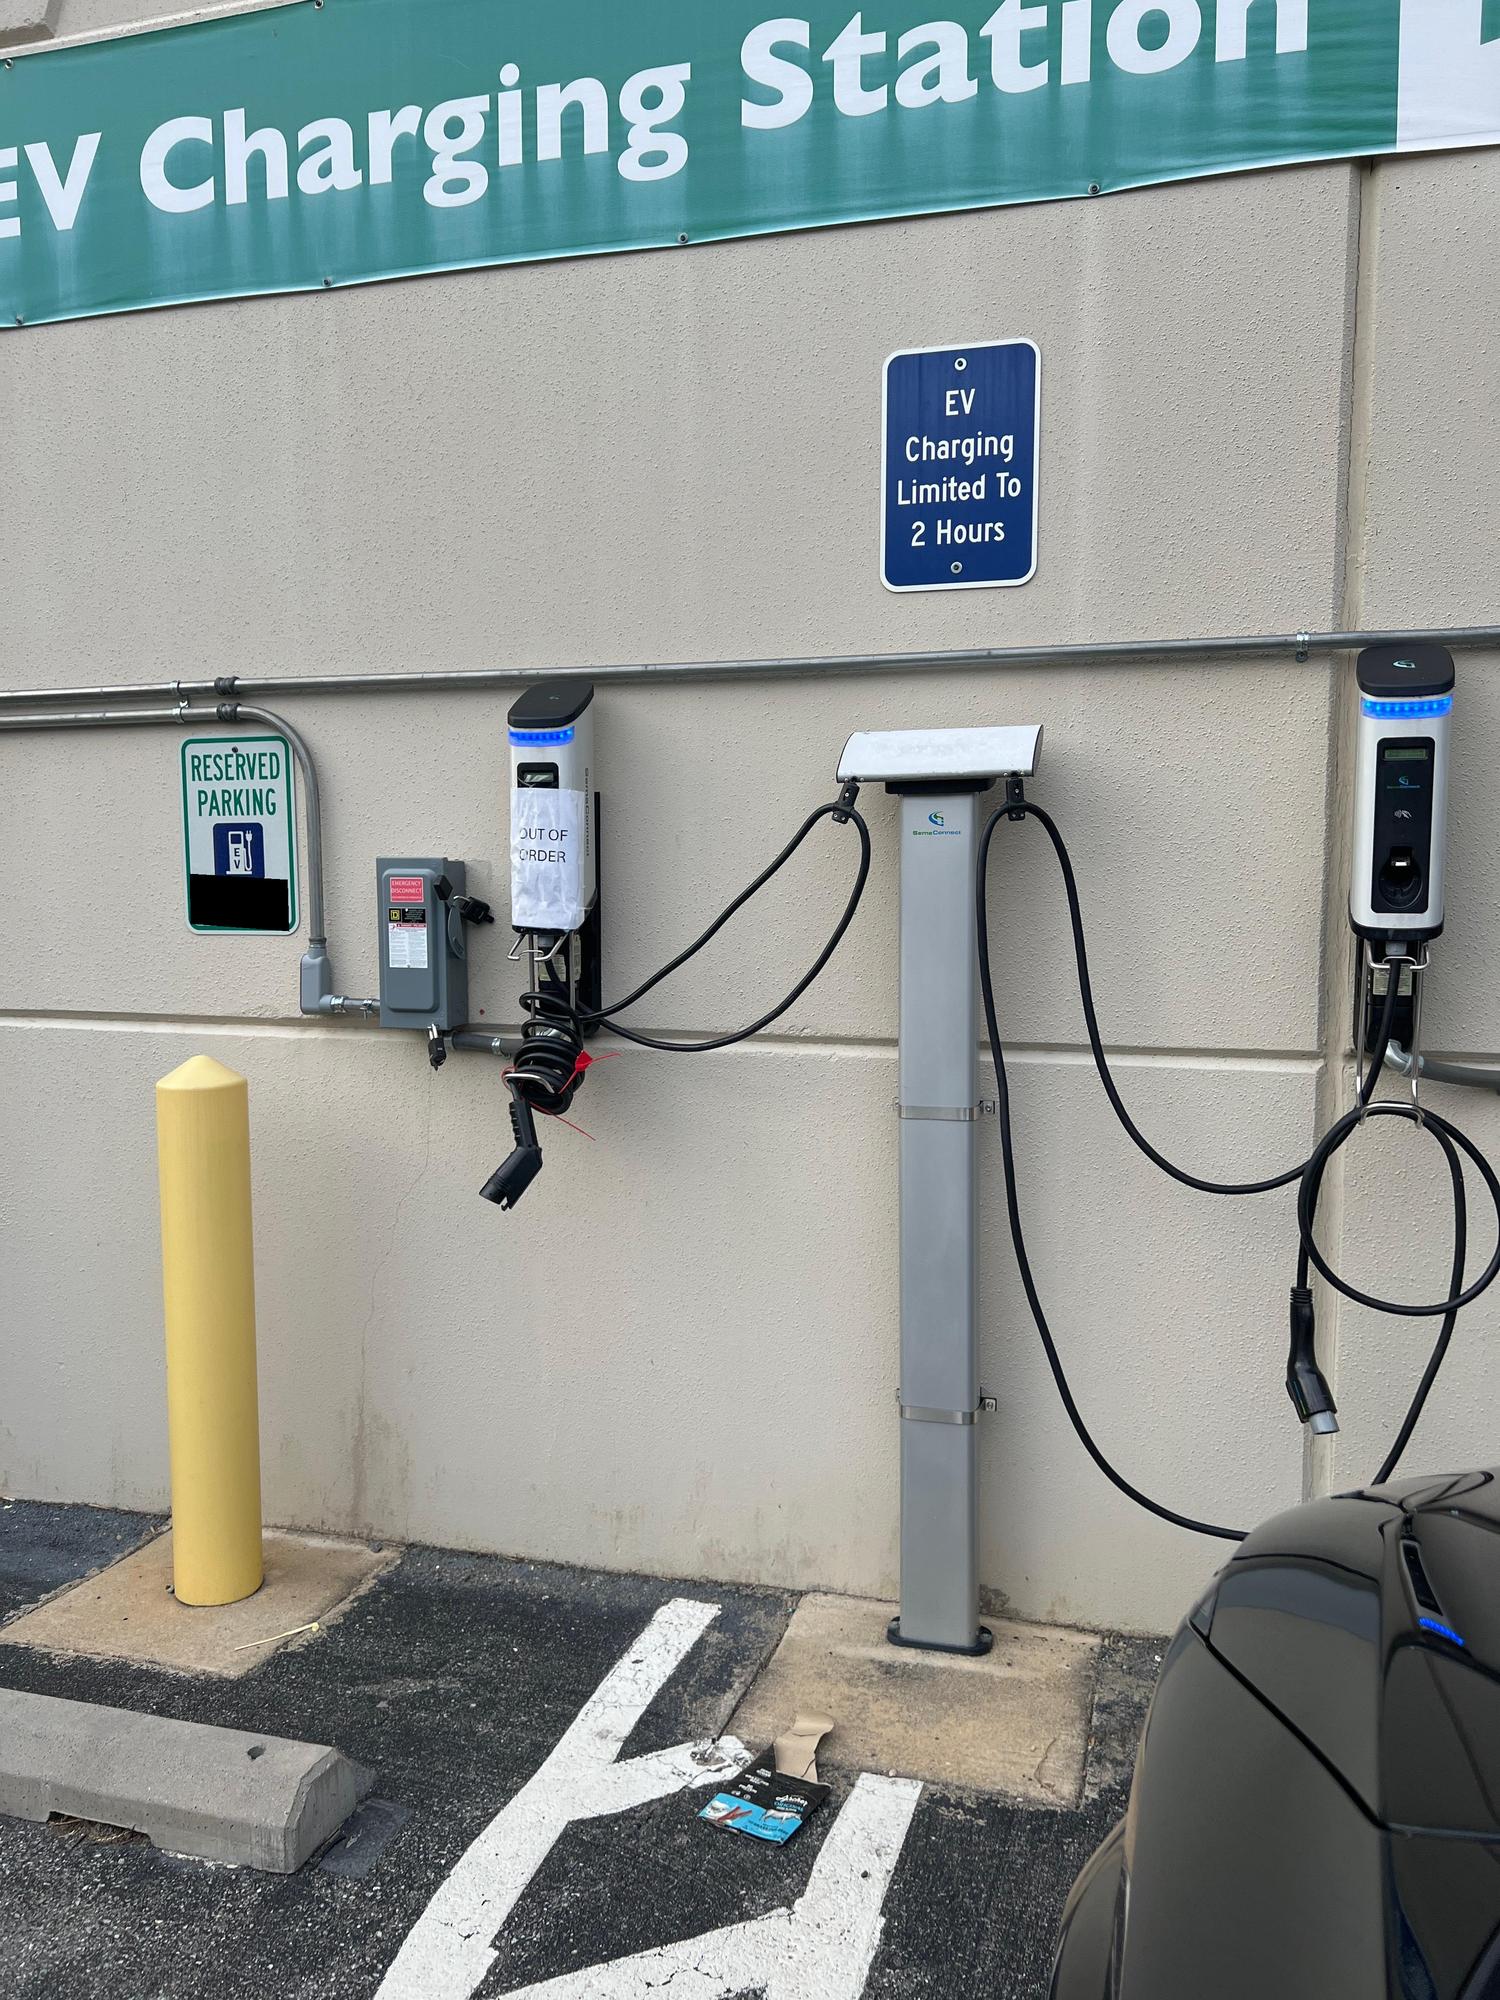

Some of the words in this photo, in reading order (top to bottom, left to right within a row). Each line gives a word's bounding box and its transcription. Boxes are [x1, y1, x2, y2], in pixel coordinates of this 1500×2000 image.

[139, 62, 691, 213] Charging
[741, 0, 1308, 130] Station
[945, 388, 975, 416] EV
[905, 431, 1014, 466] Charging
[897, 473, 985, 505] Limited
[996, 472, 1021, 498] To
[911, 521, 925, 547] 2
[936, 519, 1005, 545] Hours
[191, 752, 280, 782] RESERVED
[197, 788, 276, 817] PARKING
[519, 827, 545, 840] OUT
[548, 828, 569, 842] OF
[519, 848, 566, 863] ORDER
[390, 887, 422, 895] DISCONNECT
